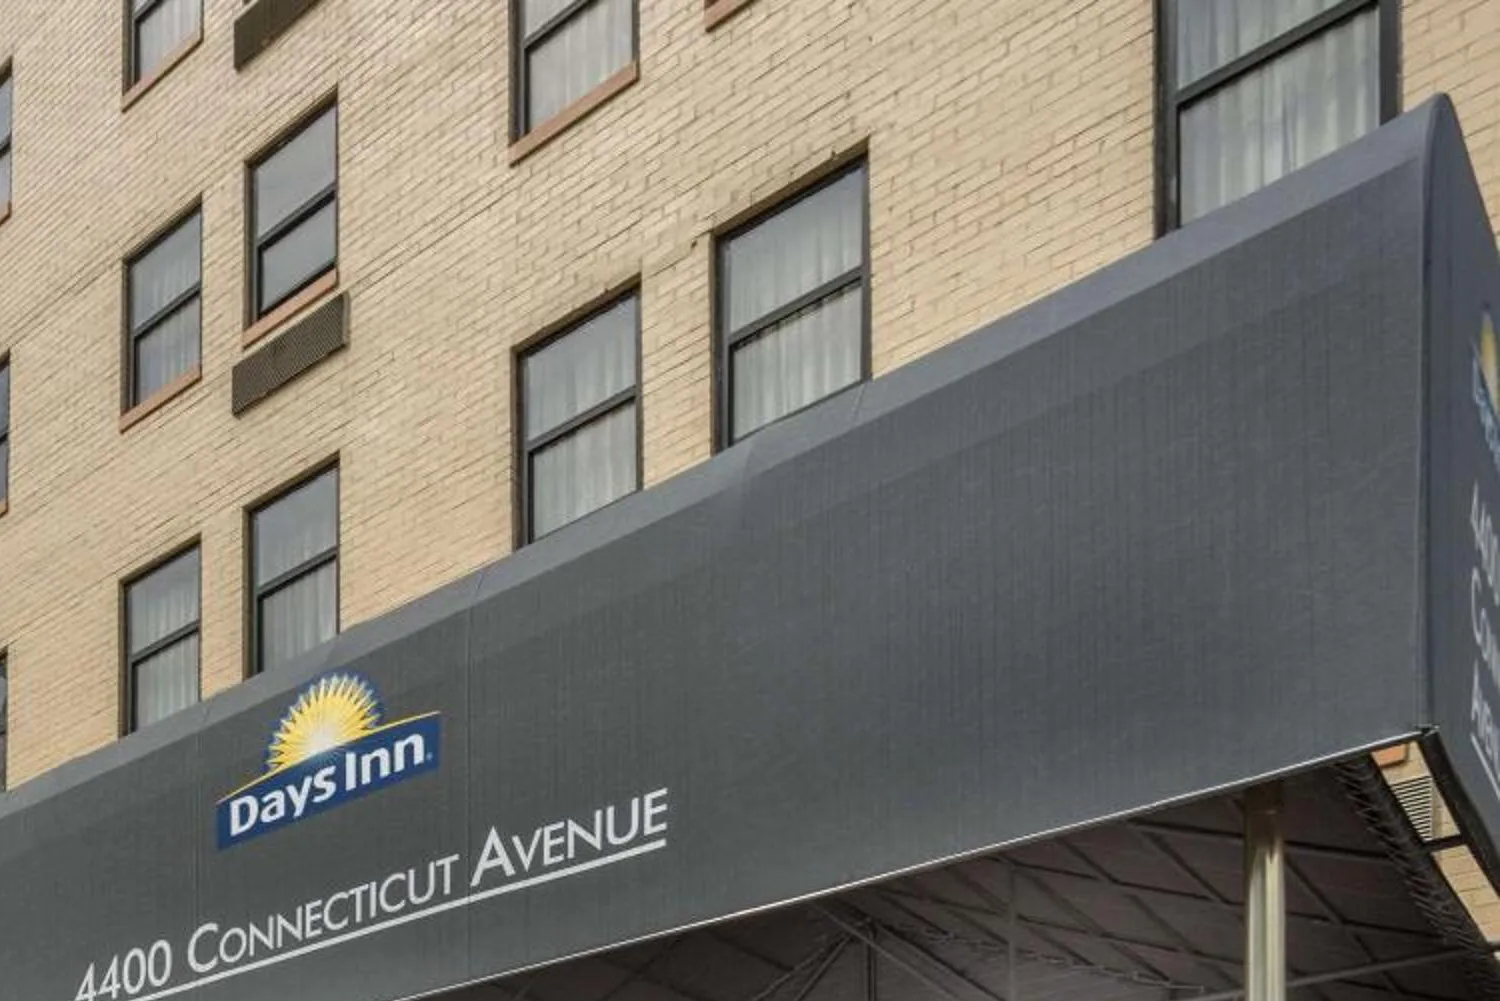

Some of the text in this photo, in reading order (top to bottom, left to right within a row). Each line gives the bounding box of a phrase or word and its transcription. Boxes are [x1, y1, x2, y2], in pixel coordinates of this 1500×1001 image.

[229, 733, 425, 837] Days Inn
[187, 853, 460, 974] CONNECTICUT
[470, 787, 668, 887] AVENUE
